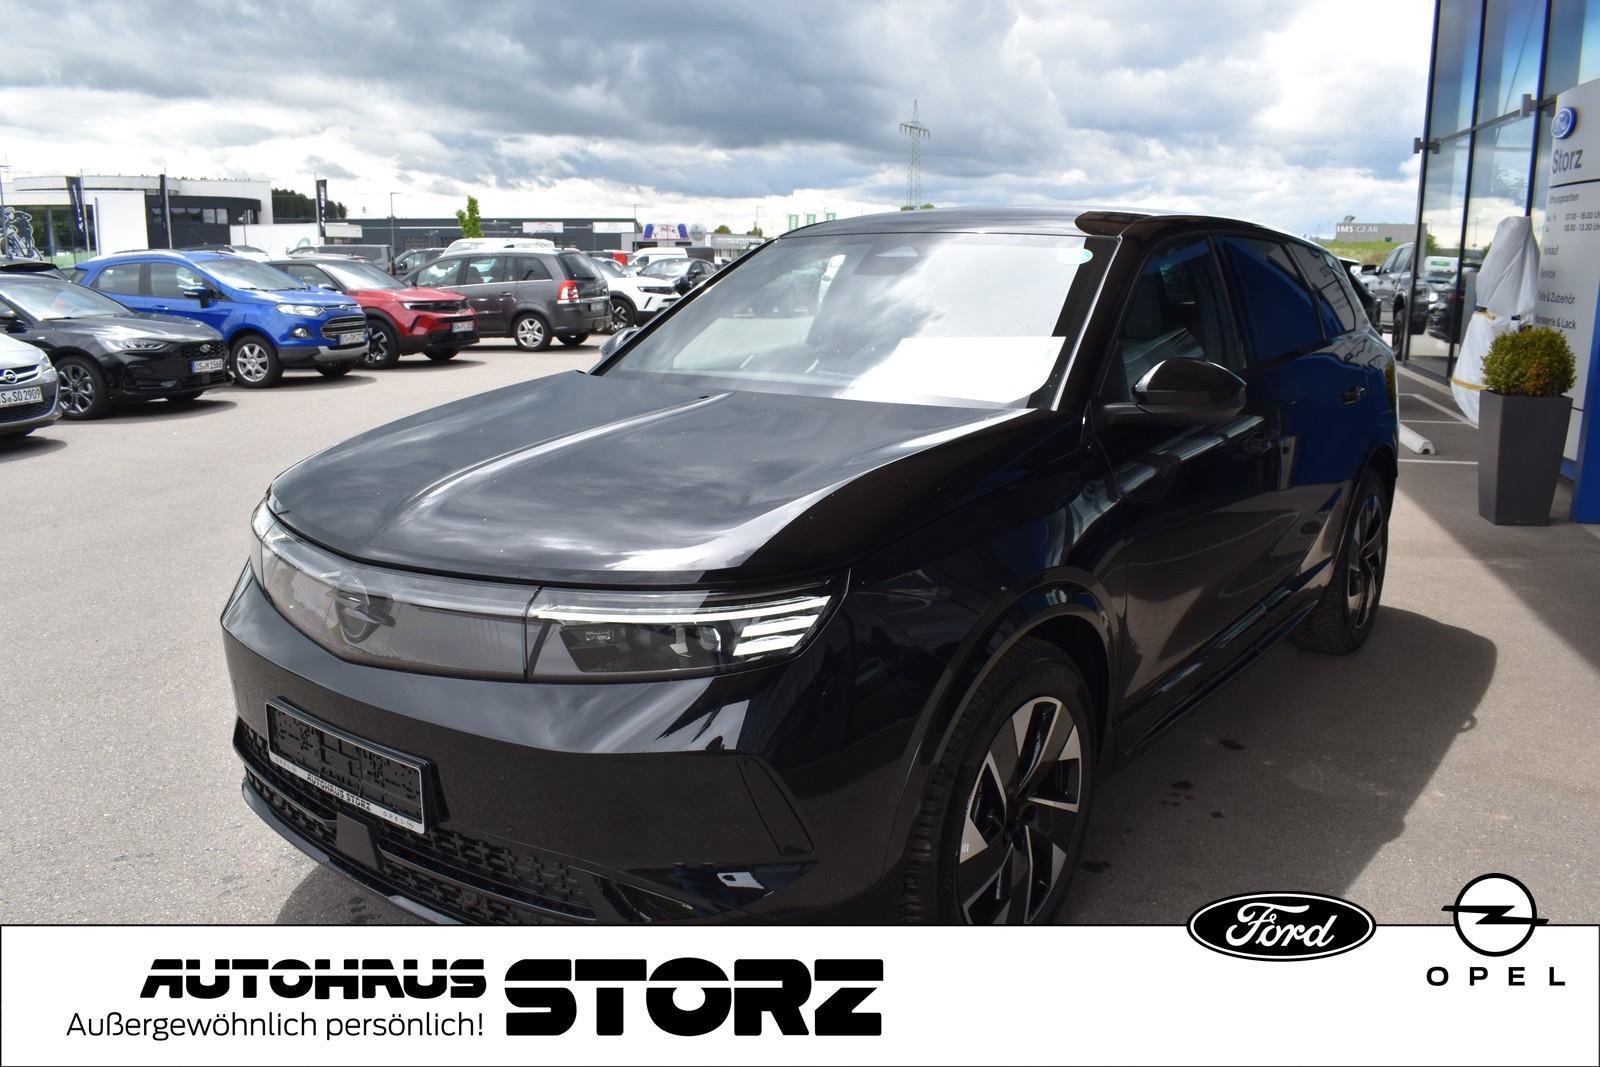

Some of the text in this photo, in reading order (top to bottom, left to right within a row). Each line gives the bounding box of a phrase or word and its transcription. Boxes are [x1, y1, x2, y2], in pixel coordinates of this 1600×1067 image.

[1552, 149, 1583, 174] Storz
[1561, 318, 1577, 330] Lack
[306, 773, 372, 811] AUTOHAUS STORZ
